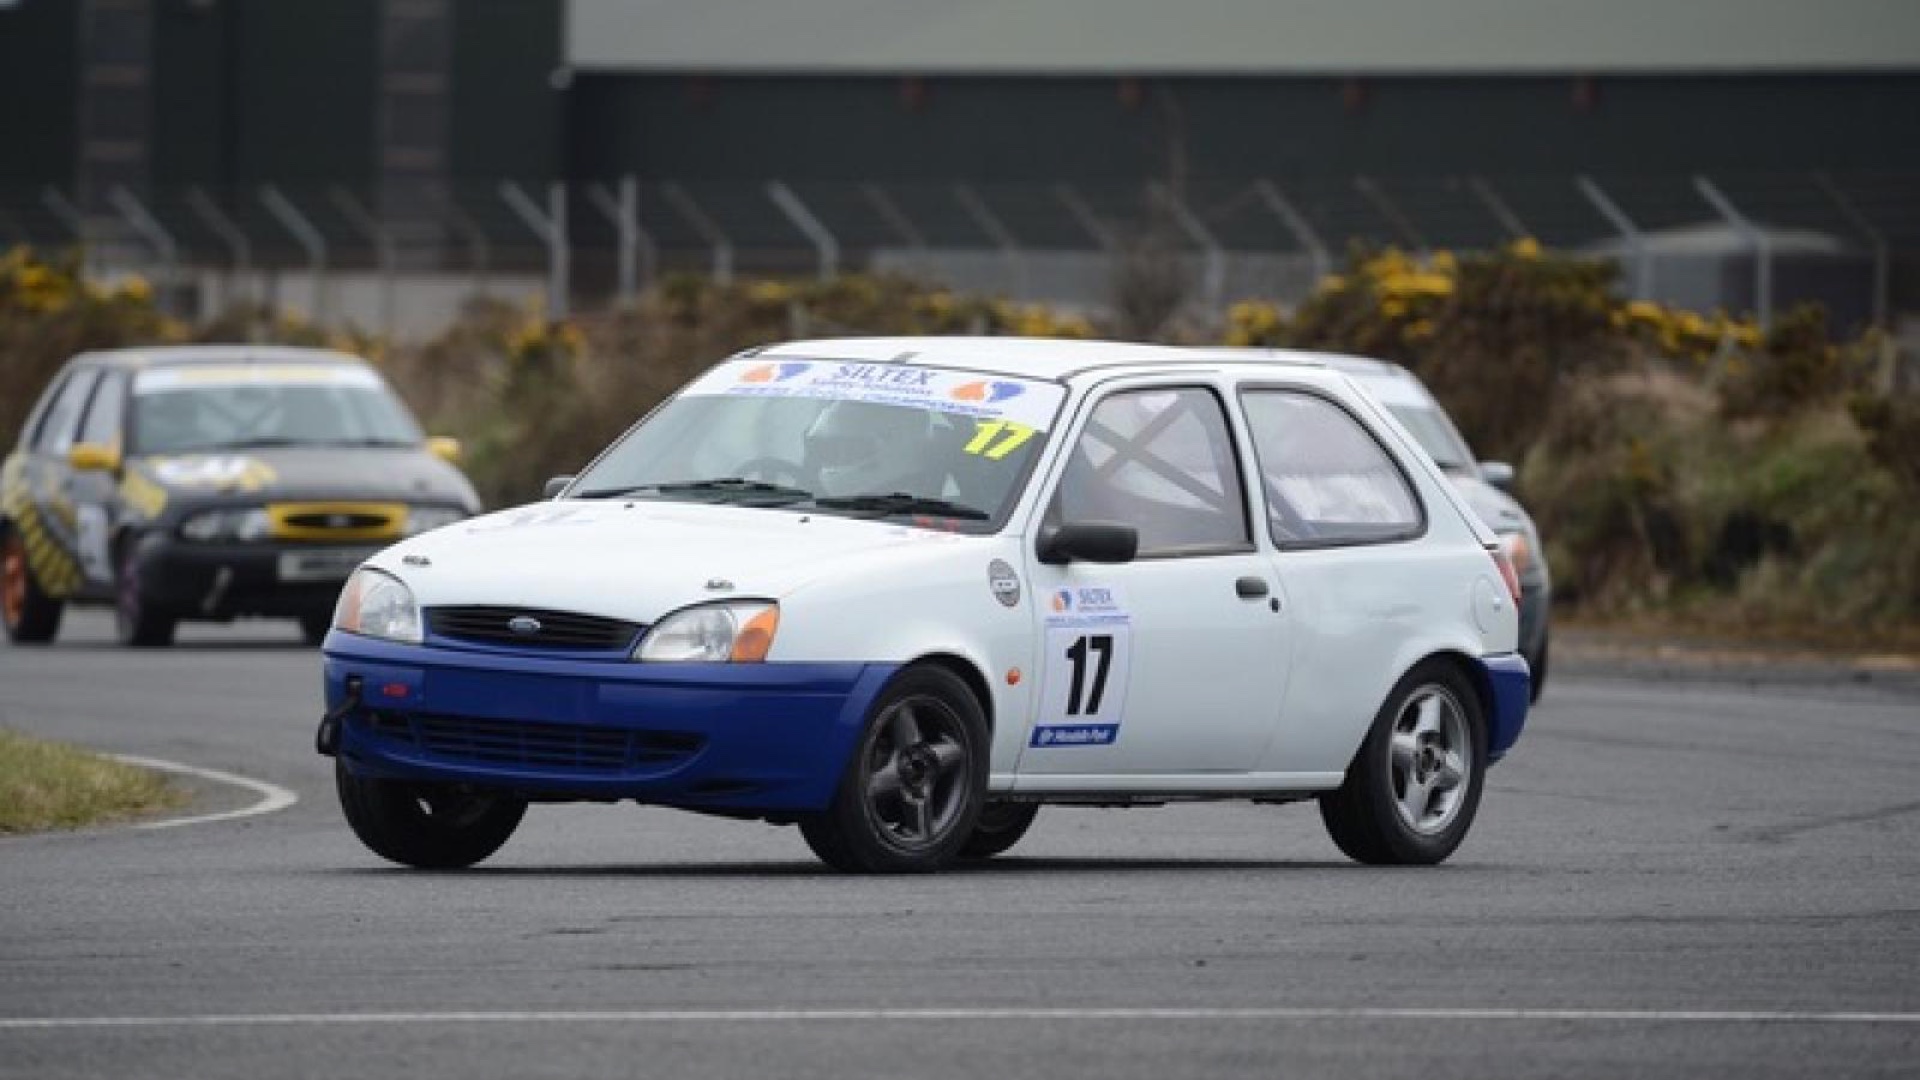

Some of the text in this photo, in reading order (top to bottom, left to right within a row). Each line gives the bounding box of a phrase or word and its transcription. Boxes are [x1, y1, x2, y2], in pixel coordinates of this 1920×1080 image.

[834, 363, 938, 387] SILTEX
[962, 420, 1035, 461] 17
[1065, 634, 1113, 715] 17
